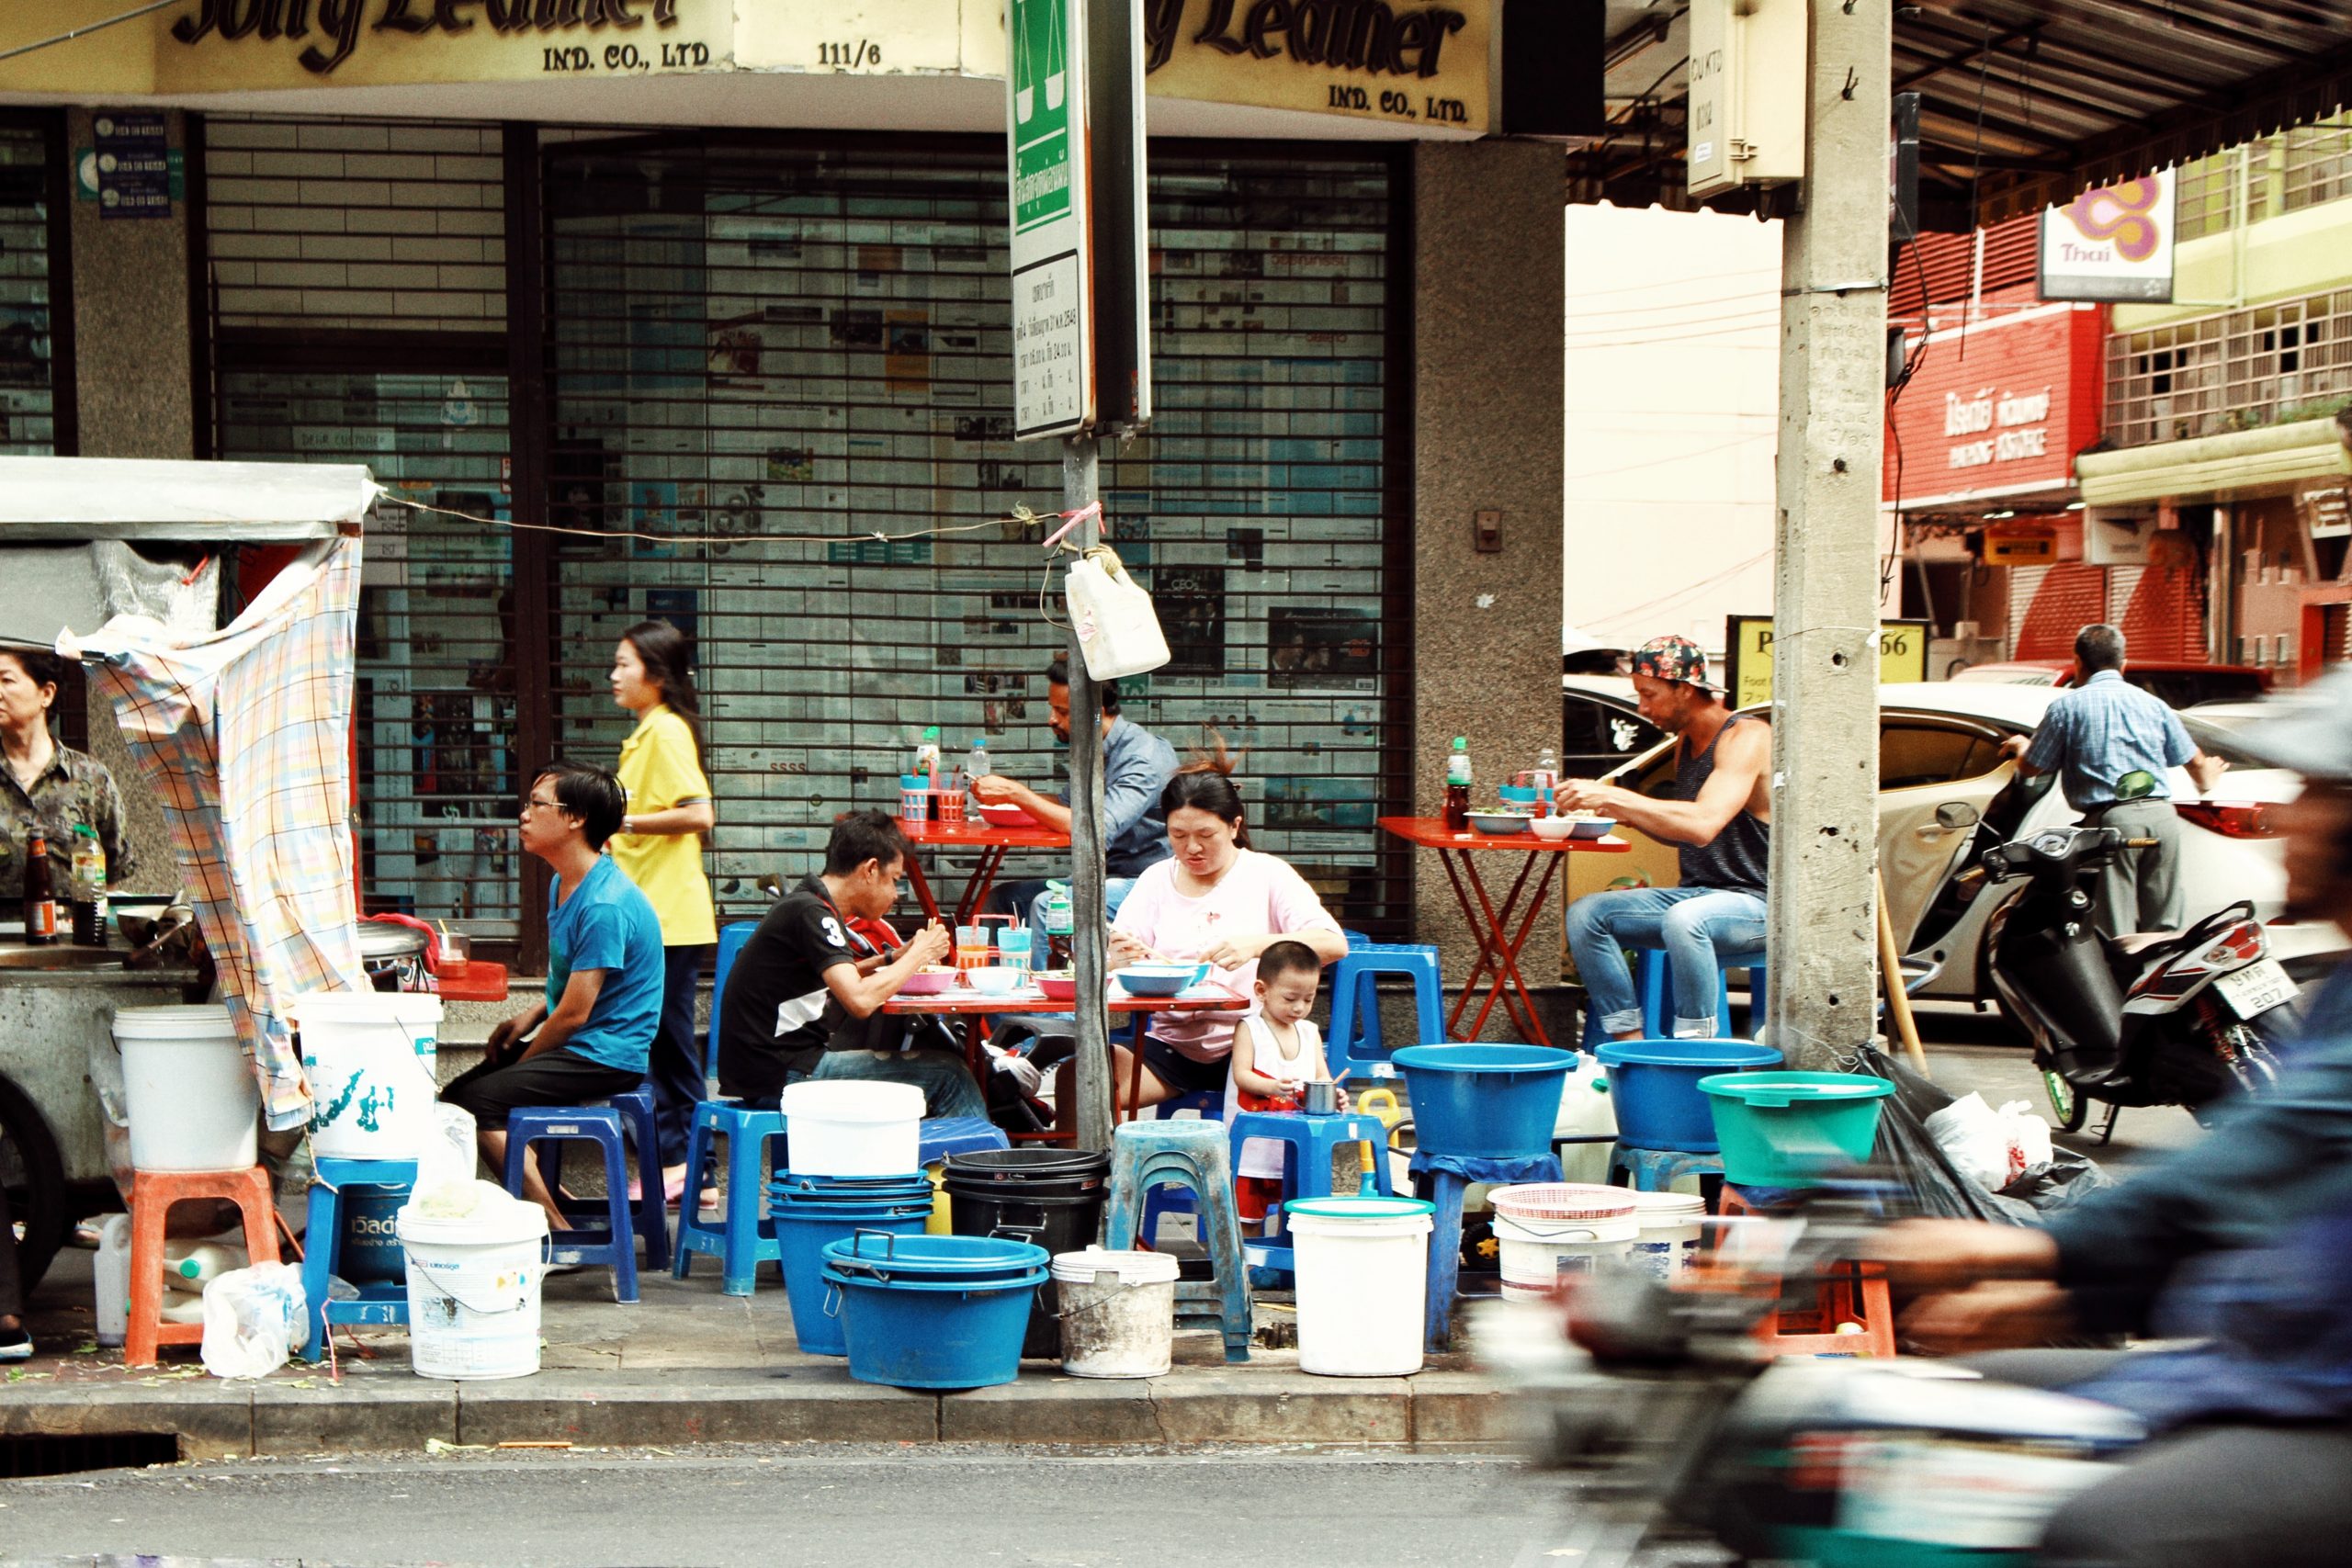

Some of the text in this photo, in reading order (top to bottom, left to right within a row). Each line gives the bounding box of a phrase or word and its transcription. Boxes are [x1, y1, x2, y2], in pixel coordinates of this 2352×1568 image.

[543, 41, 710, 72] IND. CO., LTD
[819, 39, 882, 69] 111/6
[1328, 84, 1469, 124] IND. CO., LTD.
[2060, 243, 2111, 263] Thai
[821, 916, 846, 947] 3
[2250, 987, 2282, 1009] 207
